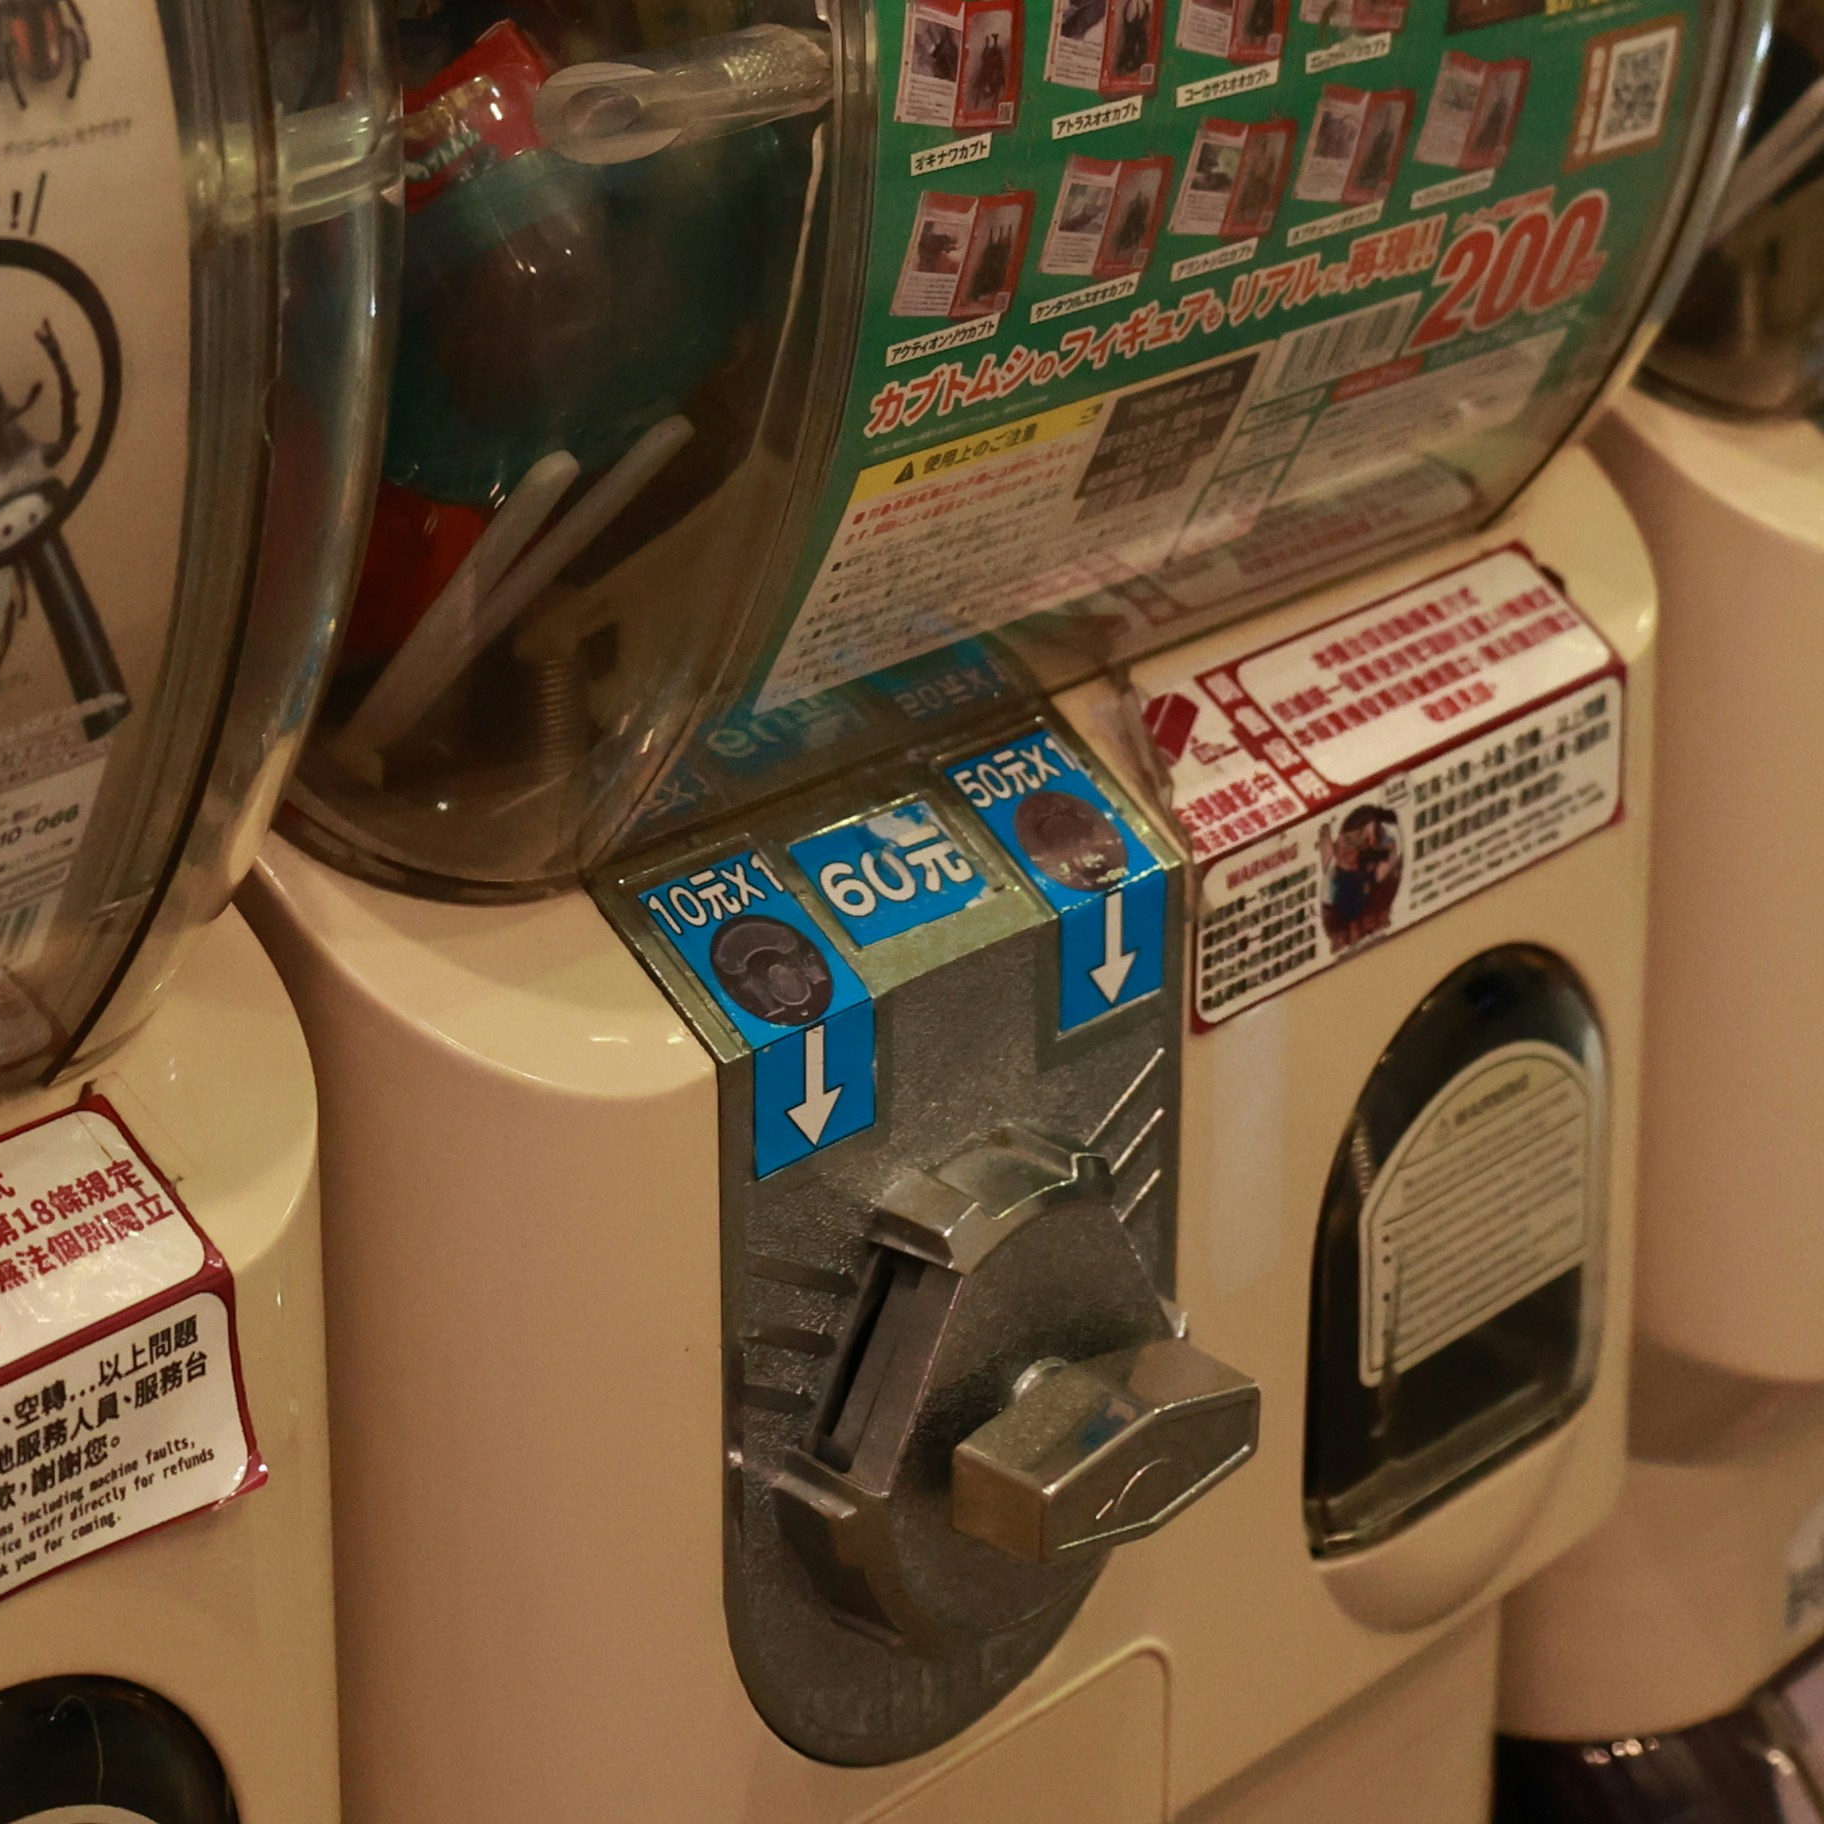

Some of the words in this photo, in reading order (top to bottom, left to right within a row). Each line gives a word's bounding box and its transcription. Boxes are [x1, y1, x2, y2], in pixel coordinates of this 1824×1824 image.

[913, 138, 989, 172] オキナワカブト
[820, 824, 975, 918] 60元
[22, 1489, 85, 1527] including
[89, 1462, 140, 1492] machine
[28, 1514, 65, 1544] staff
[70, 1485, 127, 1522] directly
[134, 1475, 155, 1492] for
[162, 1449, 216, 1476] refunds
[44, 1535, 66, 1554] for
[71, 1511, 122, 1541] coming.
